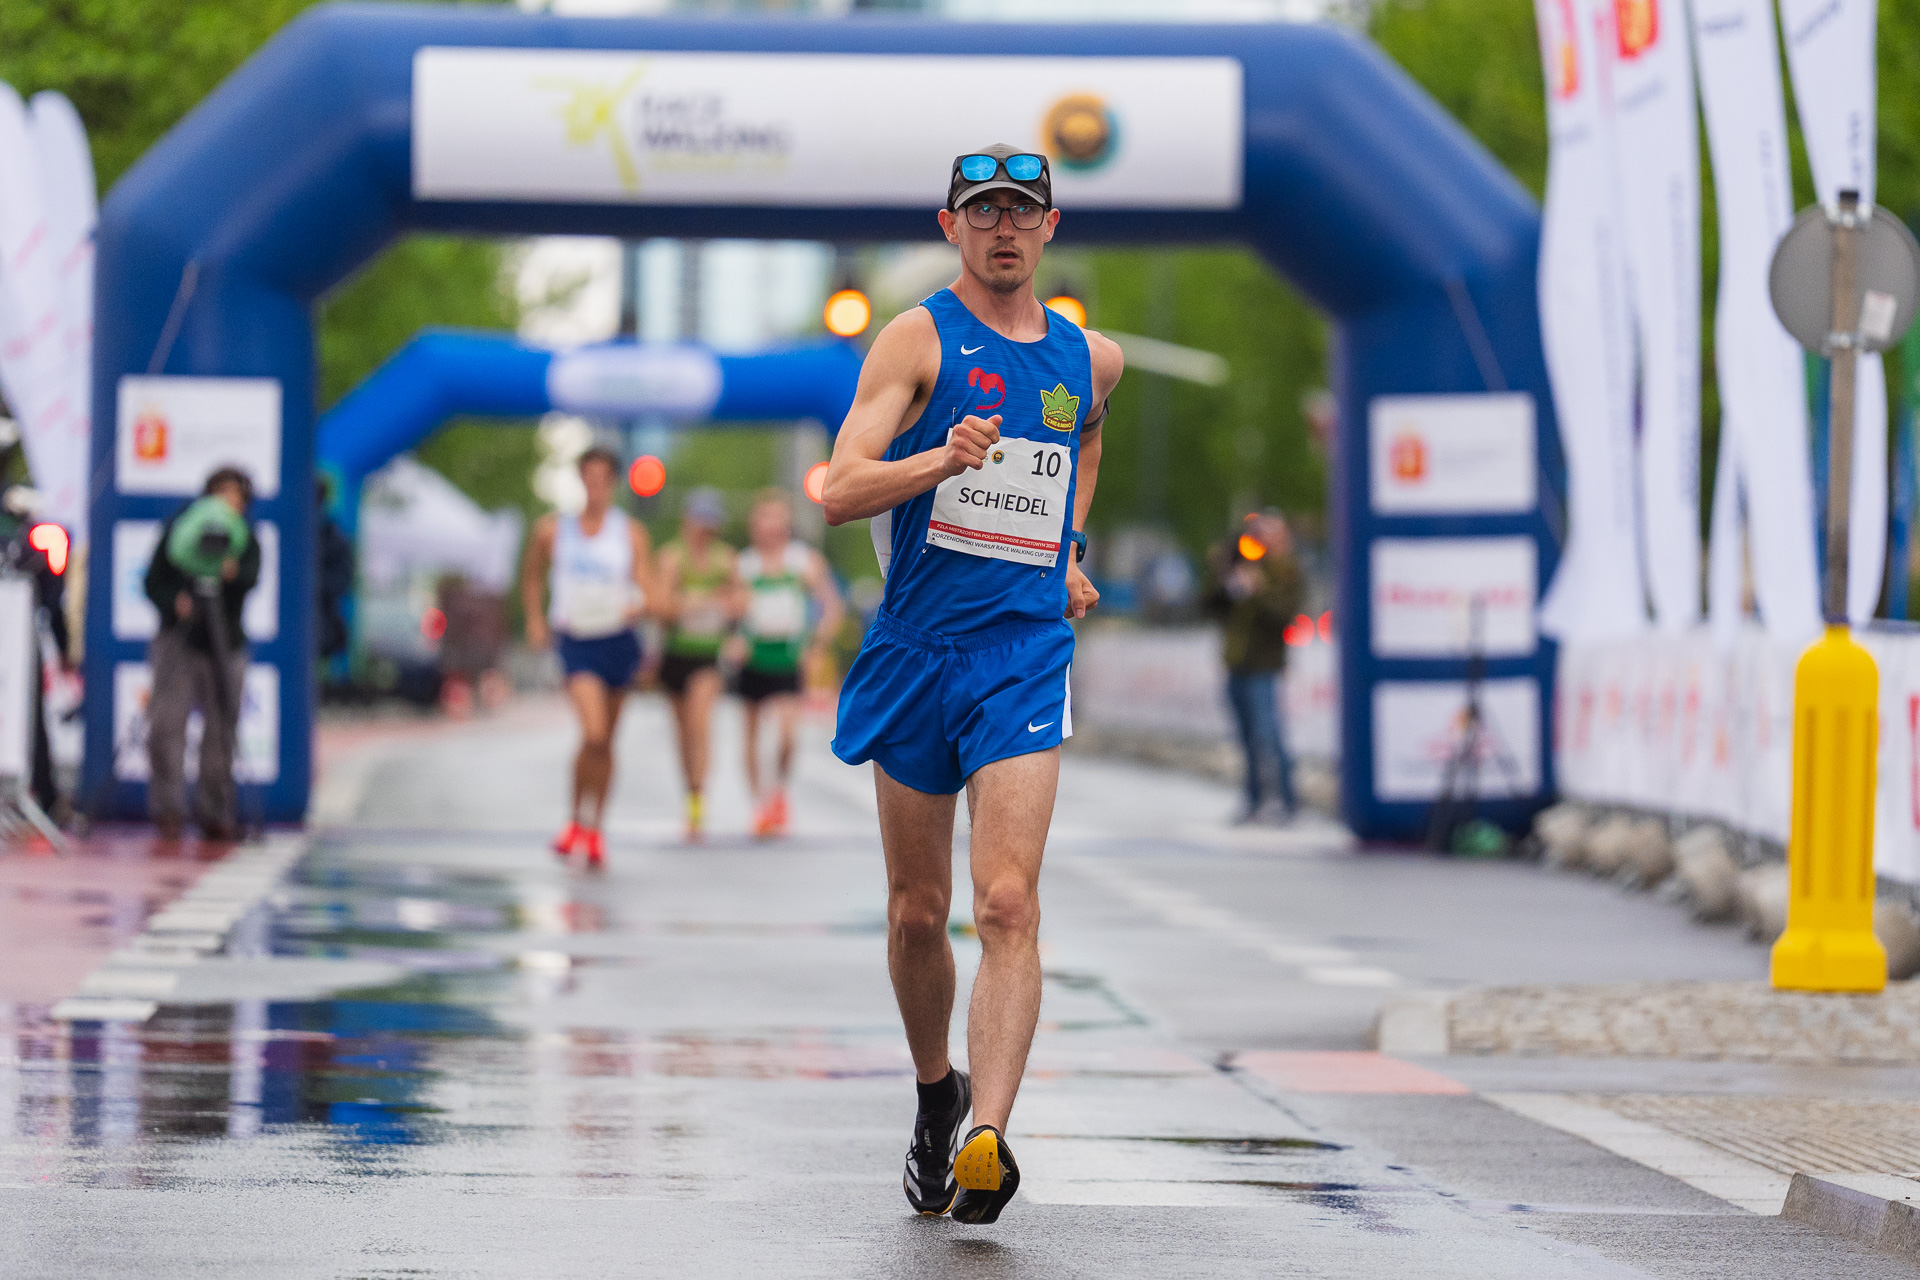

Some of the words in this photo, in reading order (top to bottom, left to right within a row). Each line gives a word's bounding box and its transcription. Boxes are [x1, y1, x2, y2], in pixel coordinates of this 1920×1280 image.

[1031, 450, 1061, 478] 10
[958, 487, 1049, 516] SCHIEDEL
[931, 532, 974, 546] KORZENIOWSKI
[995, 544, 1010, 552] RACE
[1010, 547, 1034, 556] WALKING
[999, 536, 1019, 544] CHODZIE
[1019, 539, 1046, 548] SPORTOWYM
